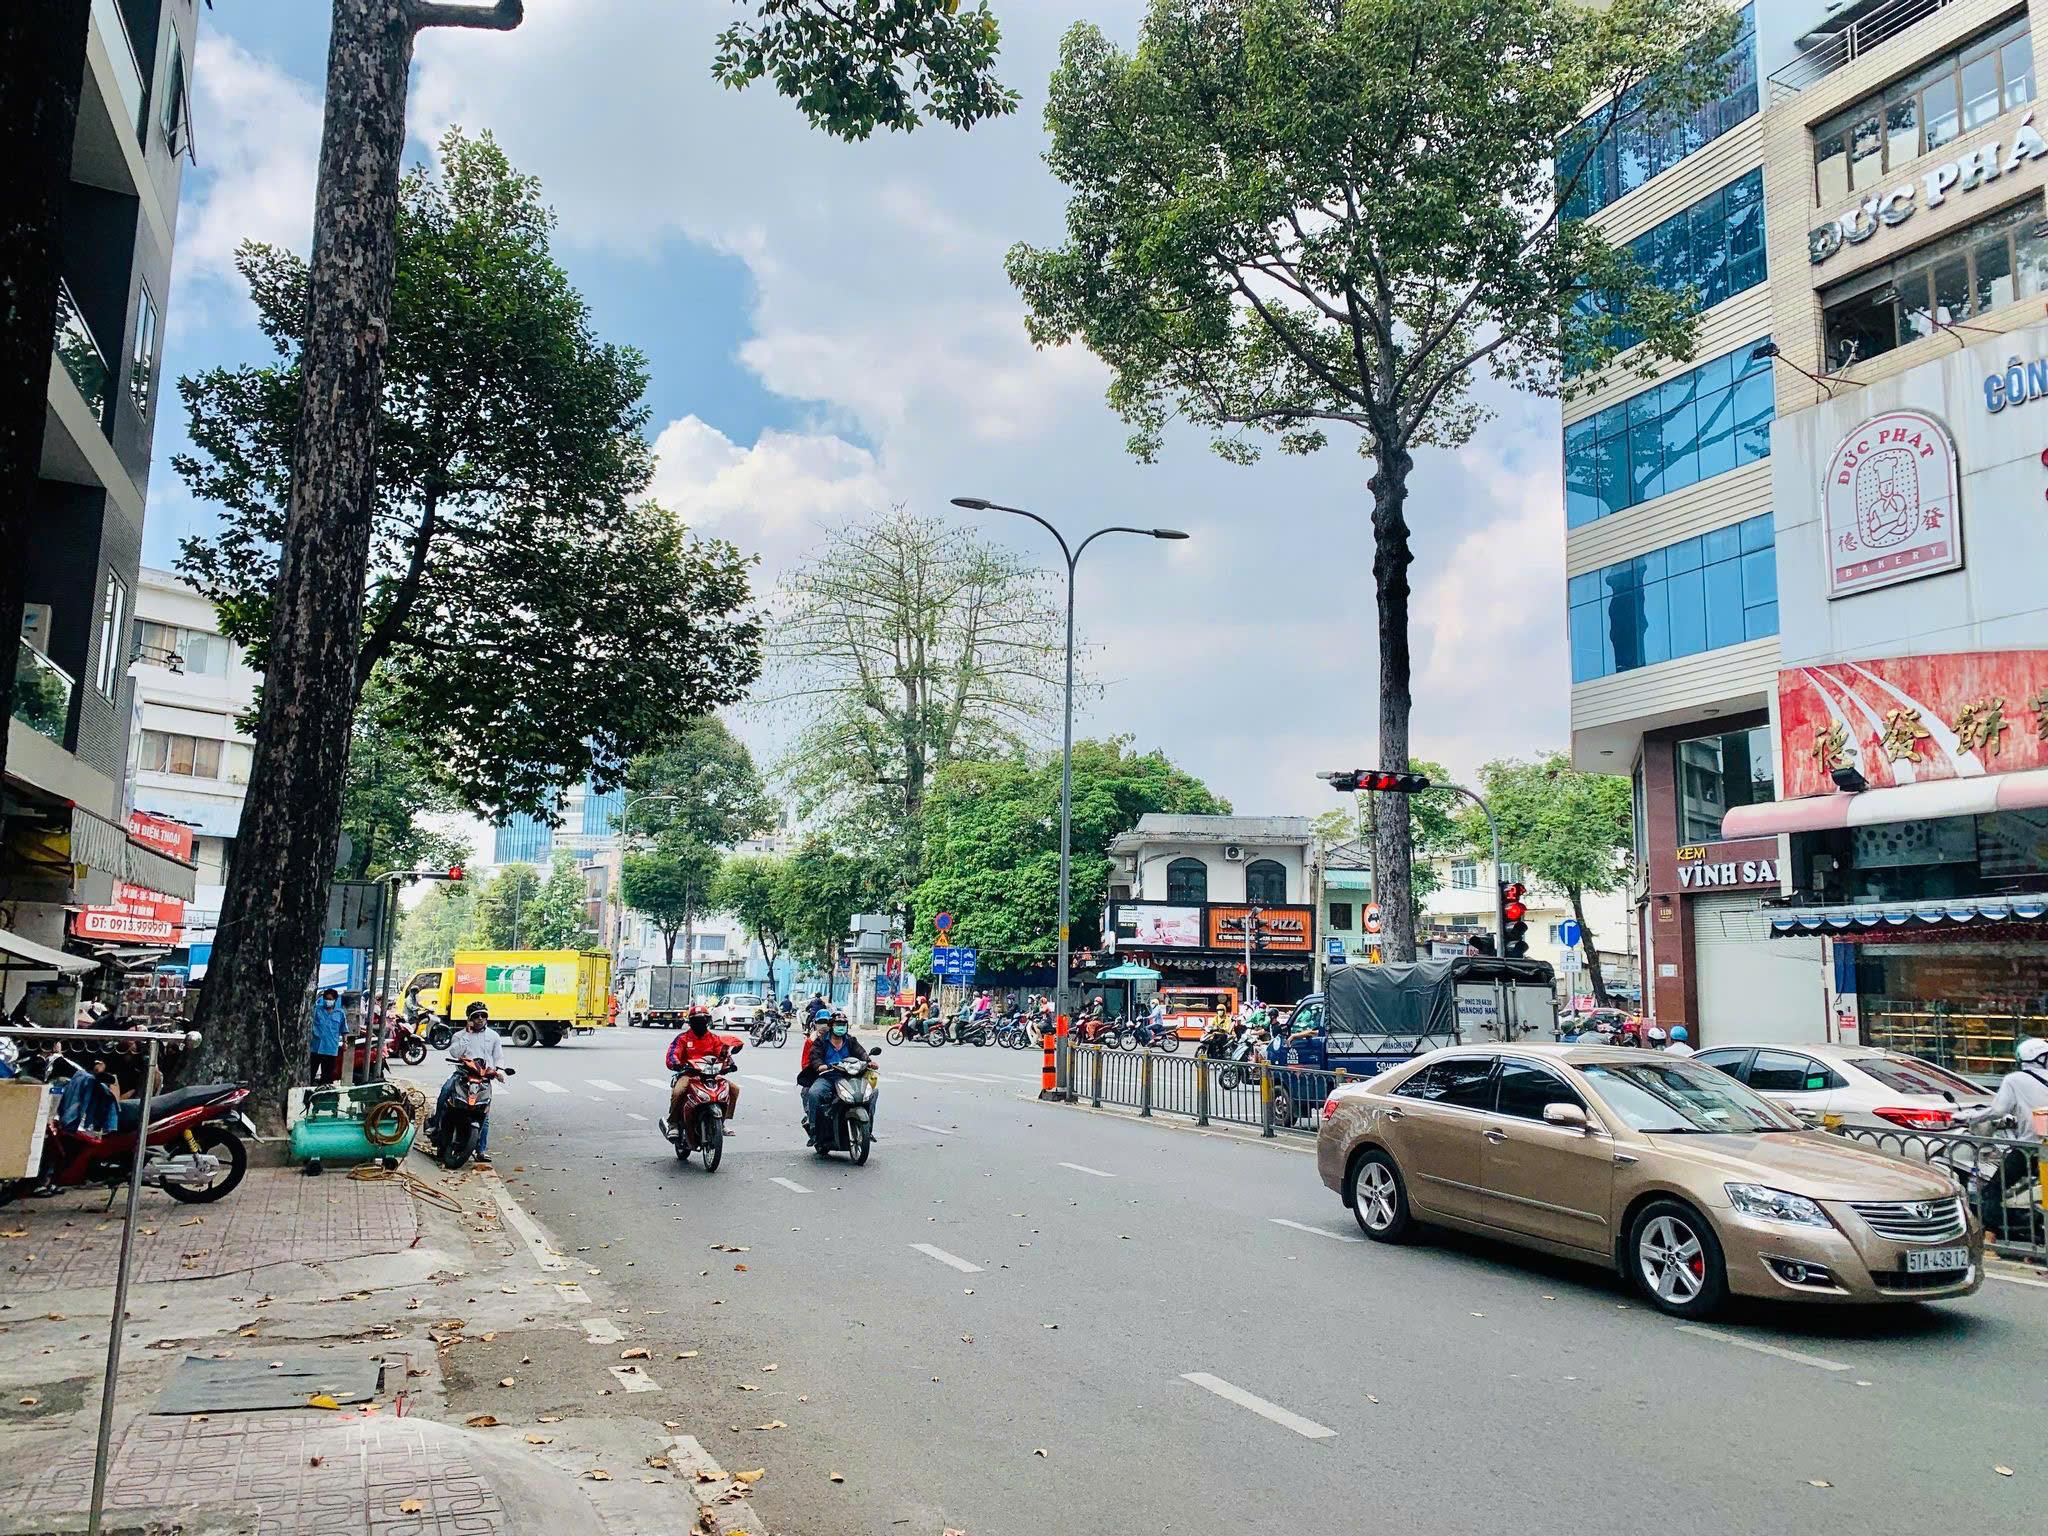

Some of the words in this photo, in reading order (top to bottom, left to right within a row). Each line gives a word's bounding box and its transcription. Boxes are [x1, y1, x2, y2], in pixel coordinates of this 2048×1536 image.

[1845, 546, 1938, 578] BAKERY
[1676, 847, 1707, 861] KEM
[1678, 860, 1738, 888] VĨNH
[91, 916, 107, 930] ĐT:
[1270, 918, 1304, 931] PIZZA
